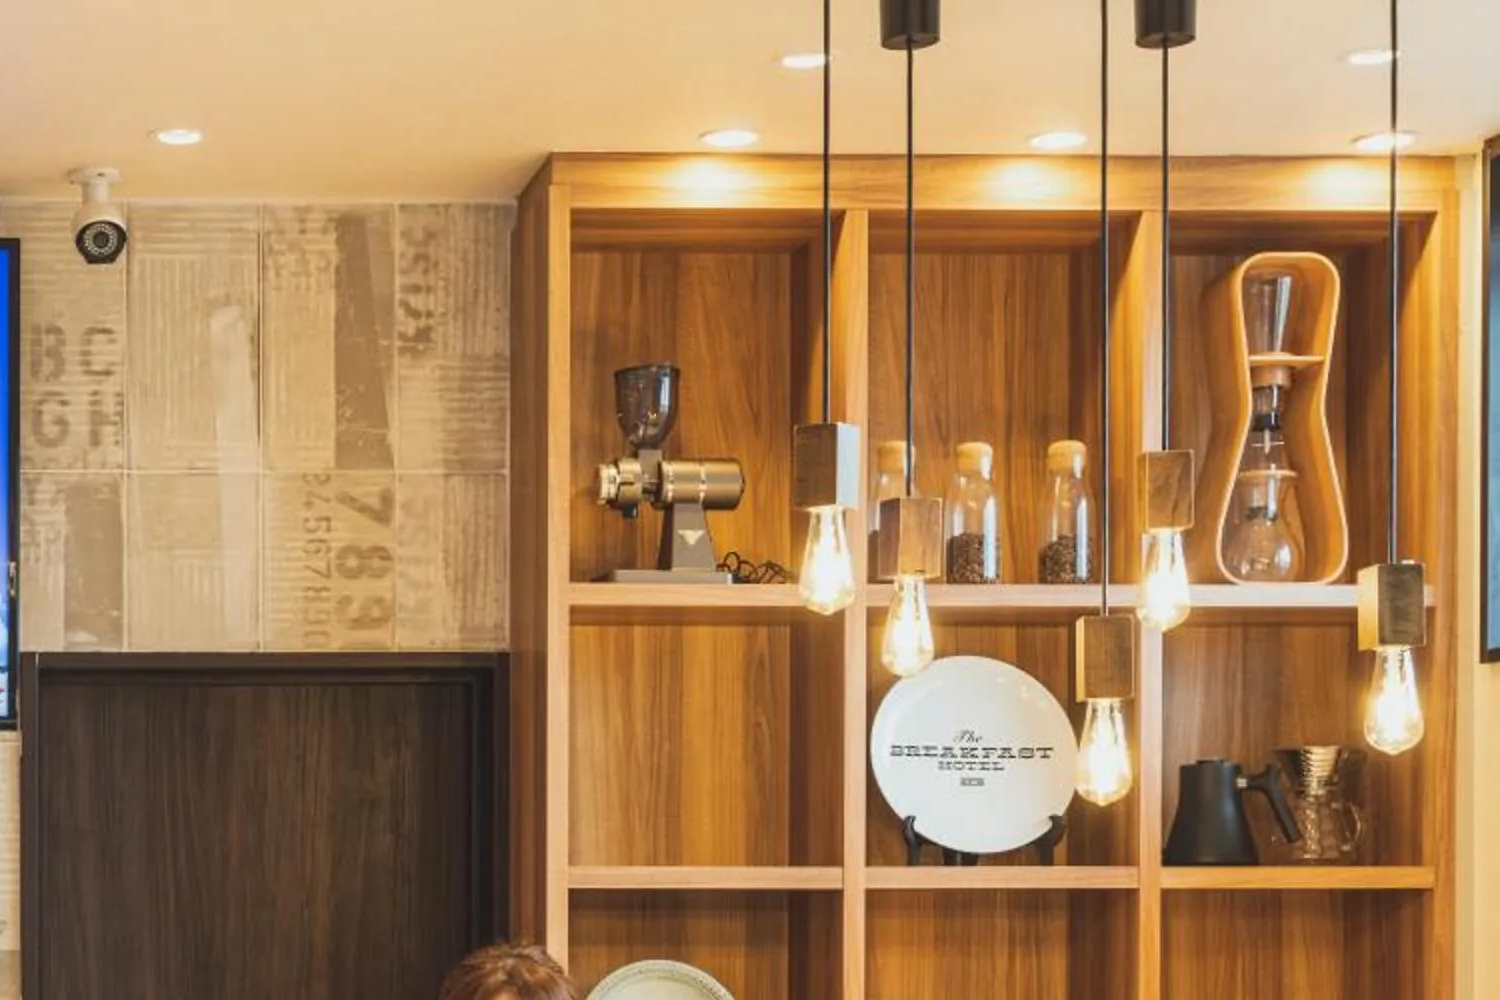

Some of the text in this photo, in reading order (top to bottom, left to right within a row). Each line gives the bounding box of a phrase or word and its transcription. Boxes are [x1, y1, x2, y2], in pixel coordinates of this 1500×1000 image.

[334, 487, 394, 650] 789
[890, 745, 1055, 759] BREAKFAST
[938, 761, 1005, 771] HOTEL
